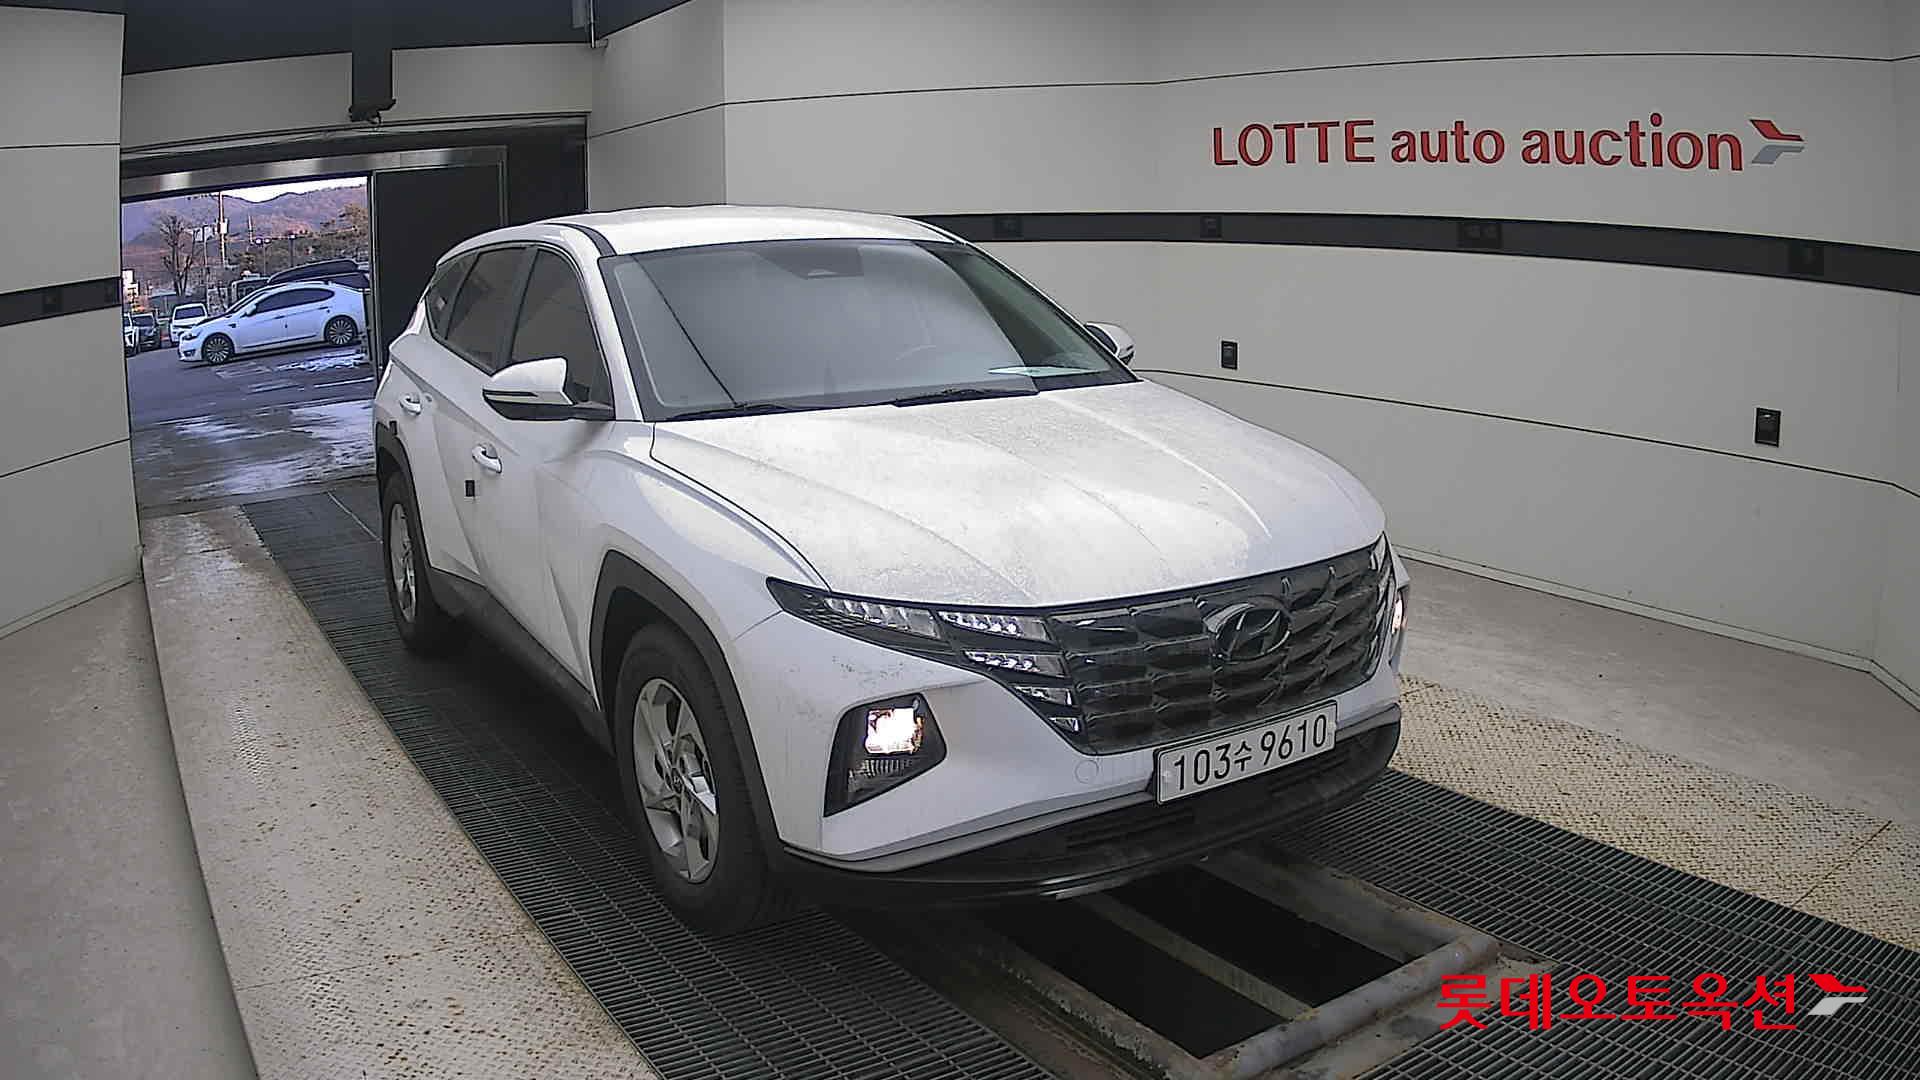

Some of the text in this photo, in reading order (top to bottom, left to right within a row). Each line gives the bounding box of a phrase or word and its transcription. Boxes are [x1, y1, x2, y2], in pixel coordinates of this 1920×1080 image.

[1212, 112, 1744, 171] LOTTE auto auction
